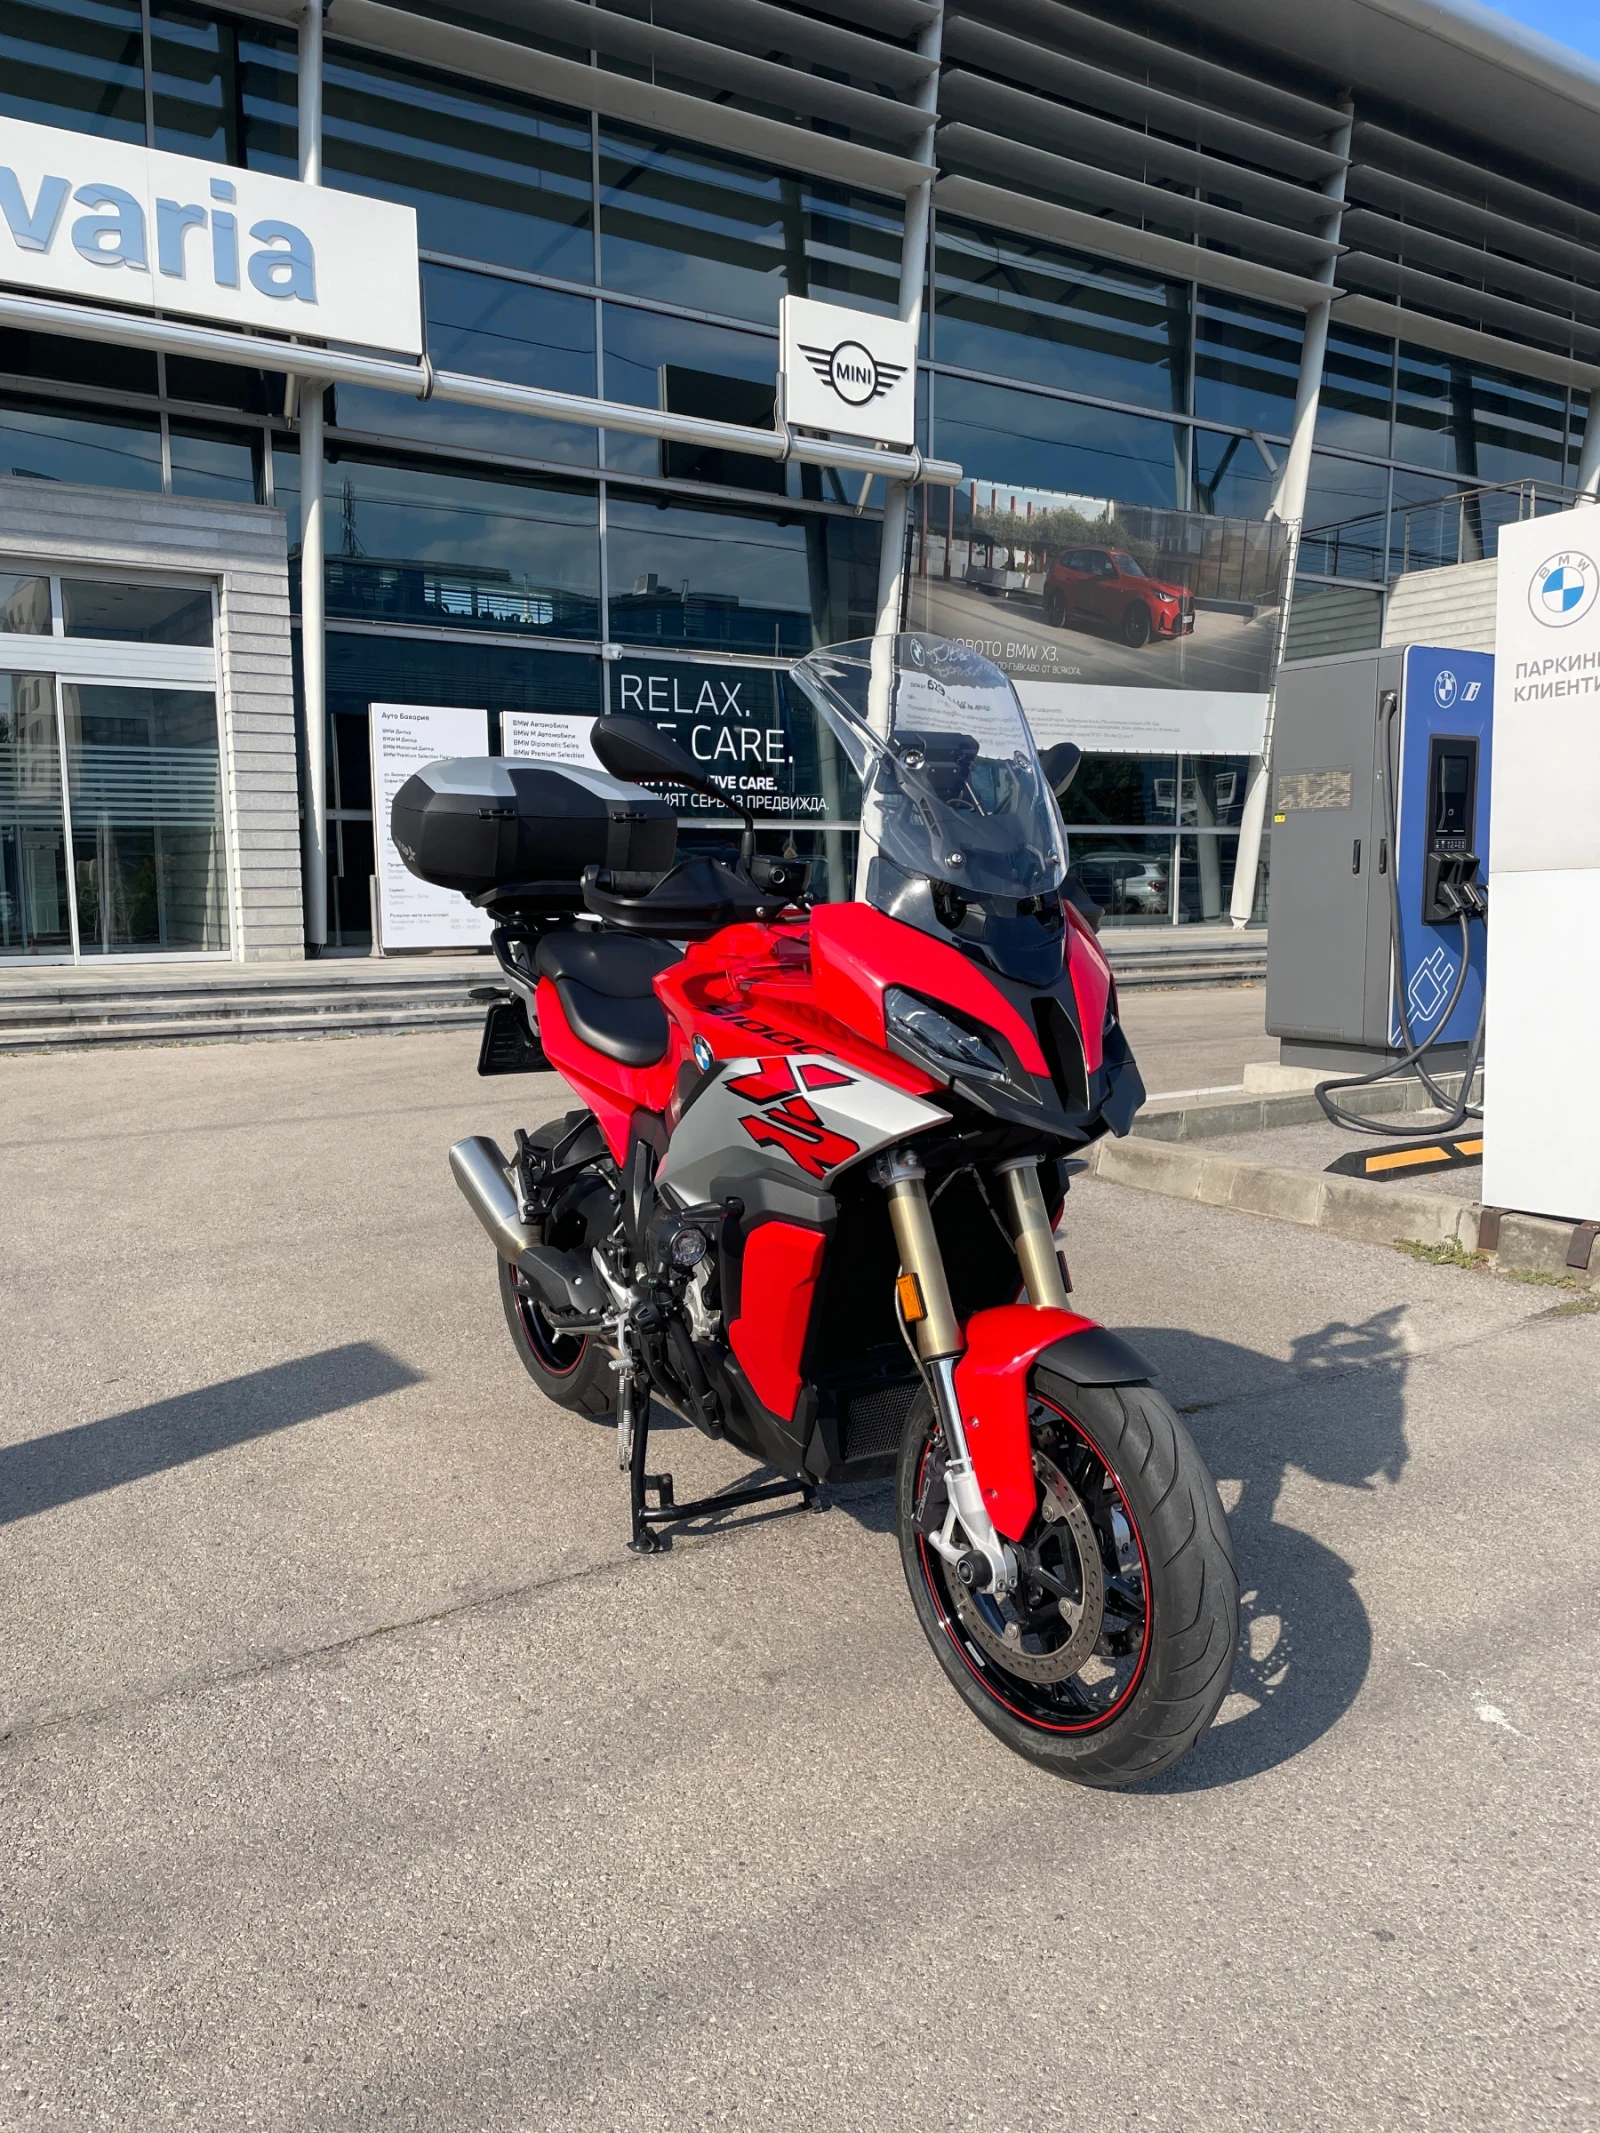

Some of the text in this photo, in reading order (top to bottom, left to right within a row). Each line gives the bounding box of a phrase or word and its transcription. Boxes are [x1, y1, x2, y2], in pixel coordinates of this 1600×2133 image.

[836, 362, 872, 386] MINI
[1538, 555, 1590, 580] BMW
[1006, 643, 1038, 660] BMW
[1041, 646, 1059, 662] X3.
[1041, 665, 1051, 673] ОТ
[1515, 651, 1600, 680] ПАРКИН
[620, 673, 750, 717] RELAX.
[381, 712, 430, 721] Ауто Бавария
[512, 719, 569, 730] BMW Автомобили
[513, 729, 529, 737] BMW
[537, 732, 576, 740] Автомобили
[513, 739, 530, 747] BMW
[690, 724, 794, 764] CARE.
[513, 749, 530, 757] BMW
[738, 776, 778, 791] CARE.
[746, 795, 830, 811] ПРЕДВИЖДА.
